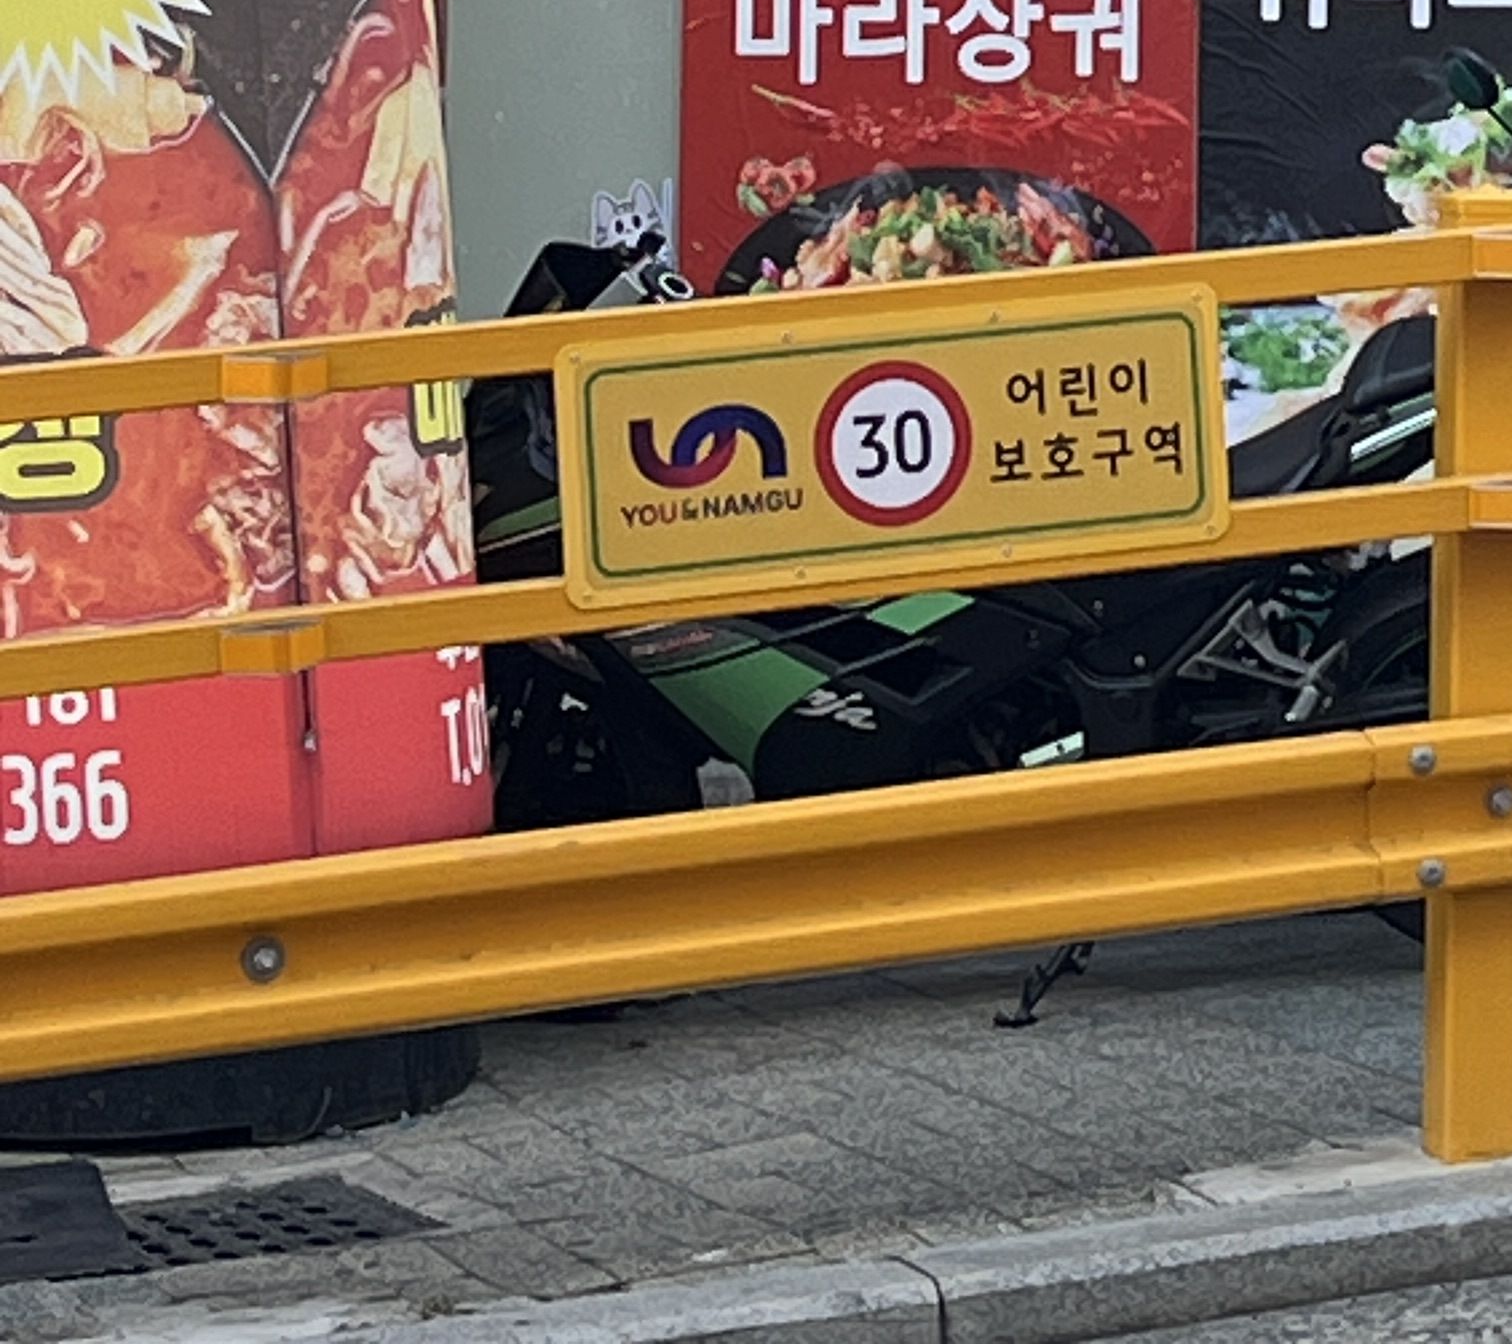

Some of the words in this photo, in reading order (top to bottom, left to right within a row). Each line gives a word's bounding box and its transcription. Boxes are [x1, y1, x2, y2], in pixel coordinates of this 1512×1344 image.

[1006, 358, 1149, 418] 어린이
[851, 410, 933, 480] 30
[989, 420, 1184, 484] 보호구역
